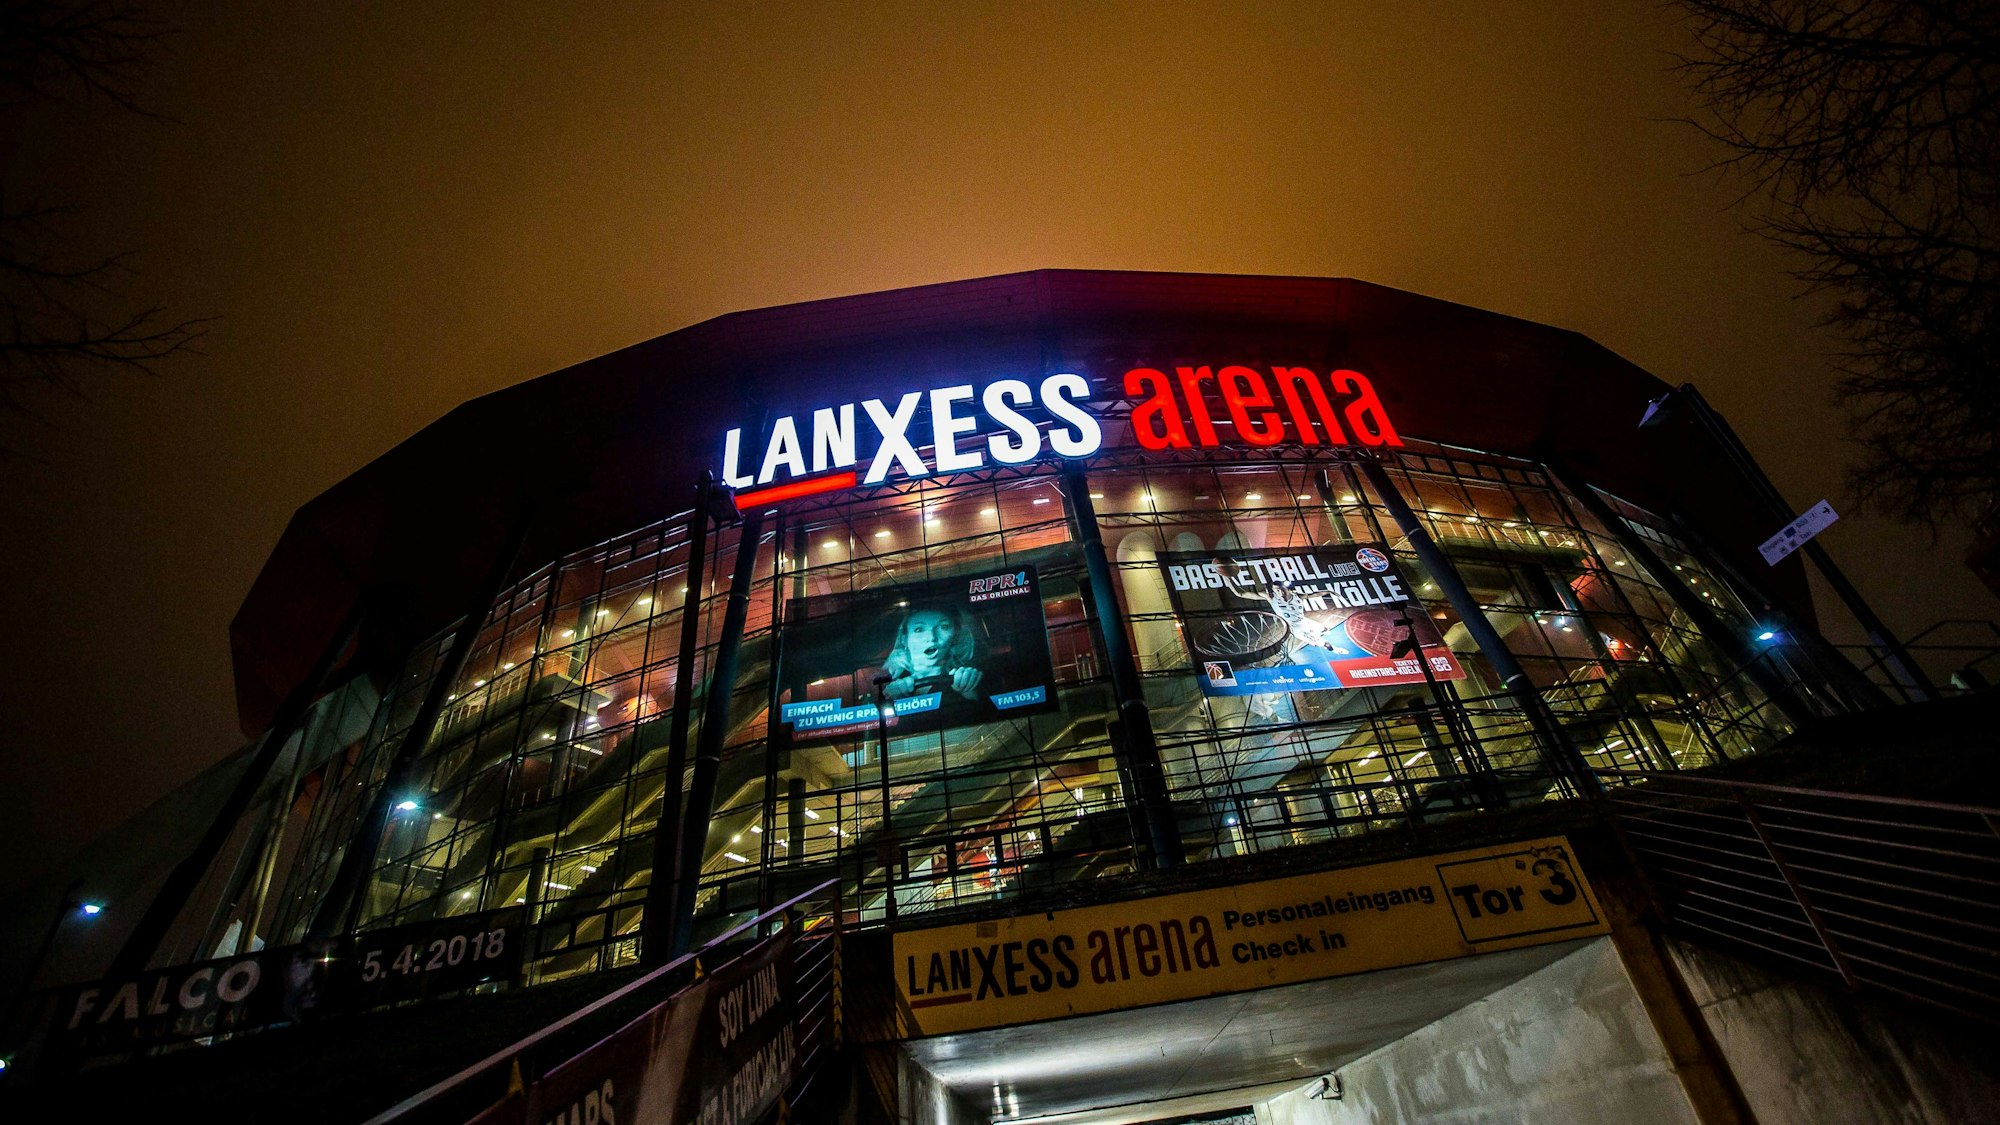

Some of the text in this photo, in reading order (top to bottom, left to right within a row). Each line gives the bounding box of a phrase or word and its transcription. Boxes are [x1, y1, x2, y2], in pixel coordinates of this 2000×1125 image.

[721, 364, 1404, 489] LANXESS arena
[971, 587, 1030, 602] DAS ORIGINAL
[787, 702, 834, 717] EINFACH
[798, 718, 813, 727] ZU
[816, 711, 854, 724] WENIG
[896, 698, 933, 712] EHÖRT
[997, 691, 1040, 706] FM 103,5
[908, 857, 1578, 1001] LANXESS arena Personaleingang Tor 3
[1231, 928, 1346, 966] Check in
[67, 928, 506, 1029] FALCO 5.4.2018
[718, 963, 782, 1048] SOY LUNA
